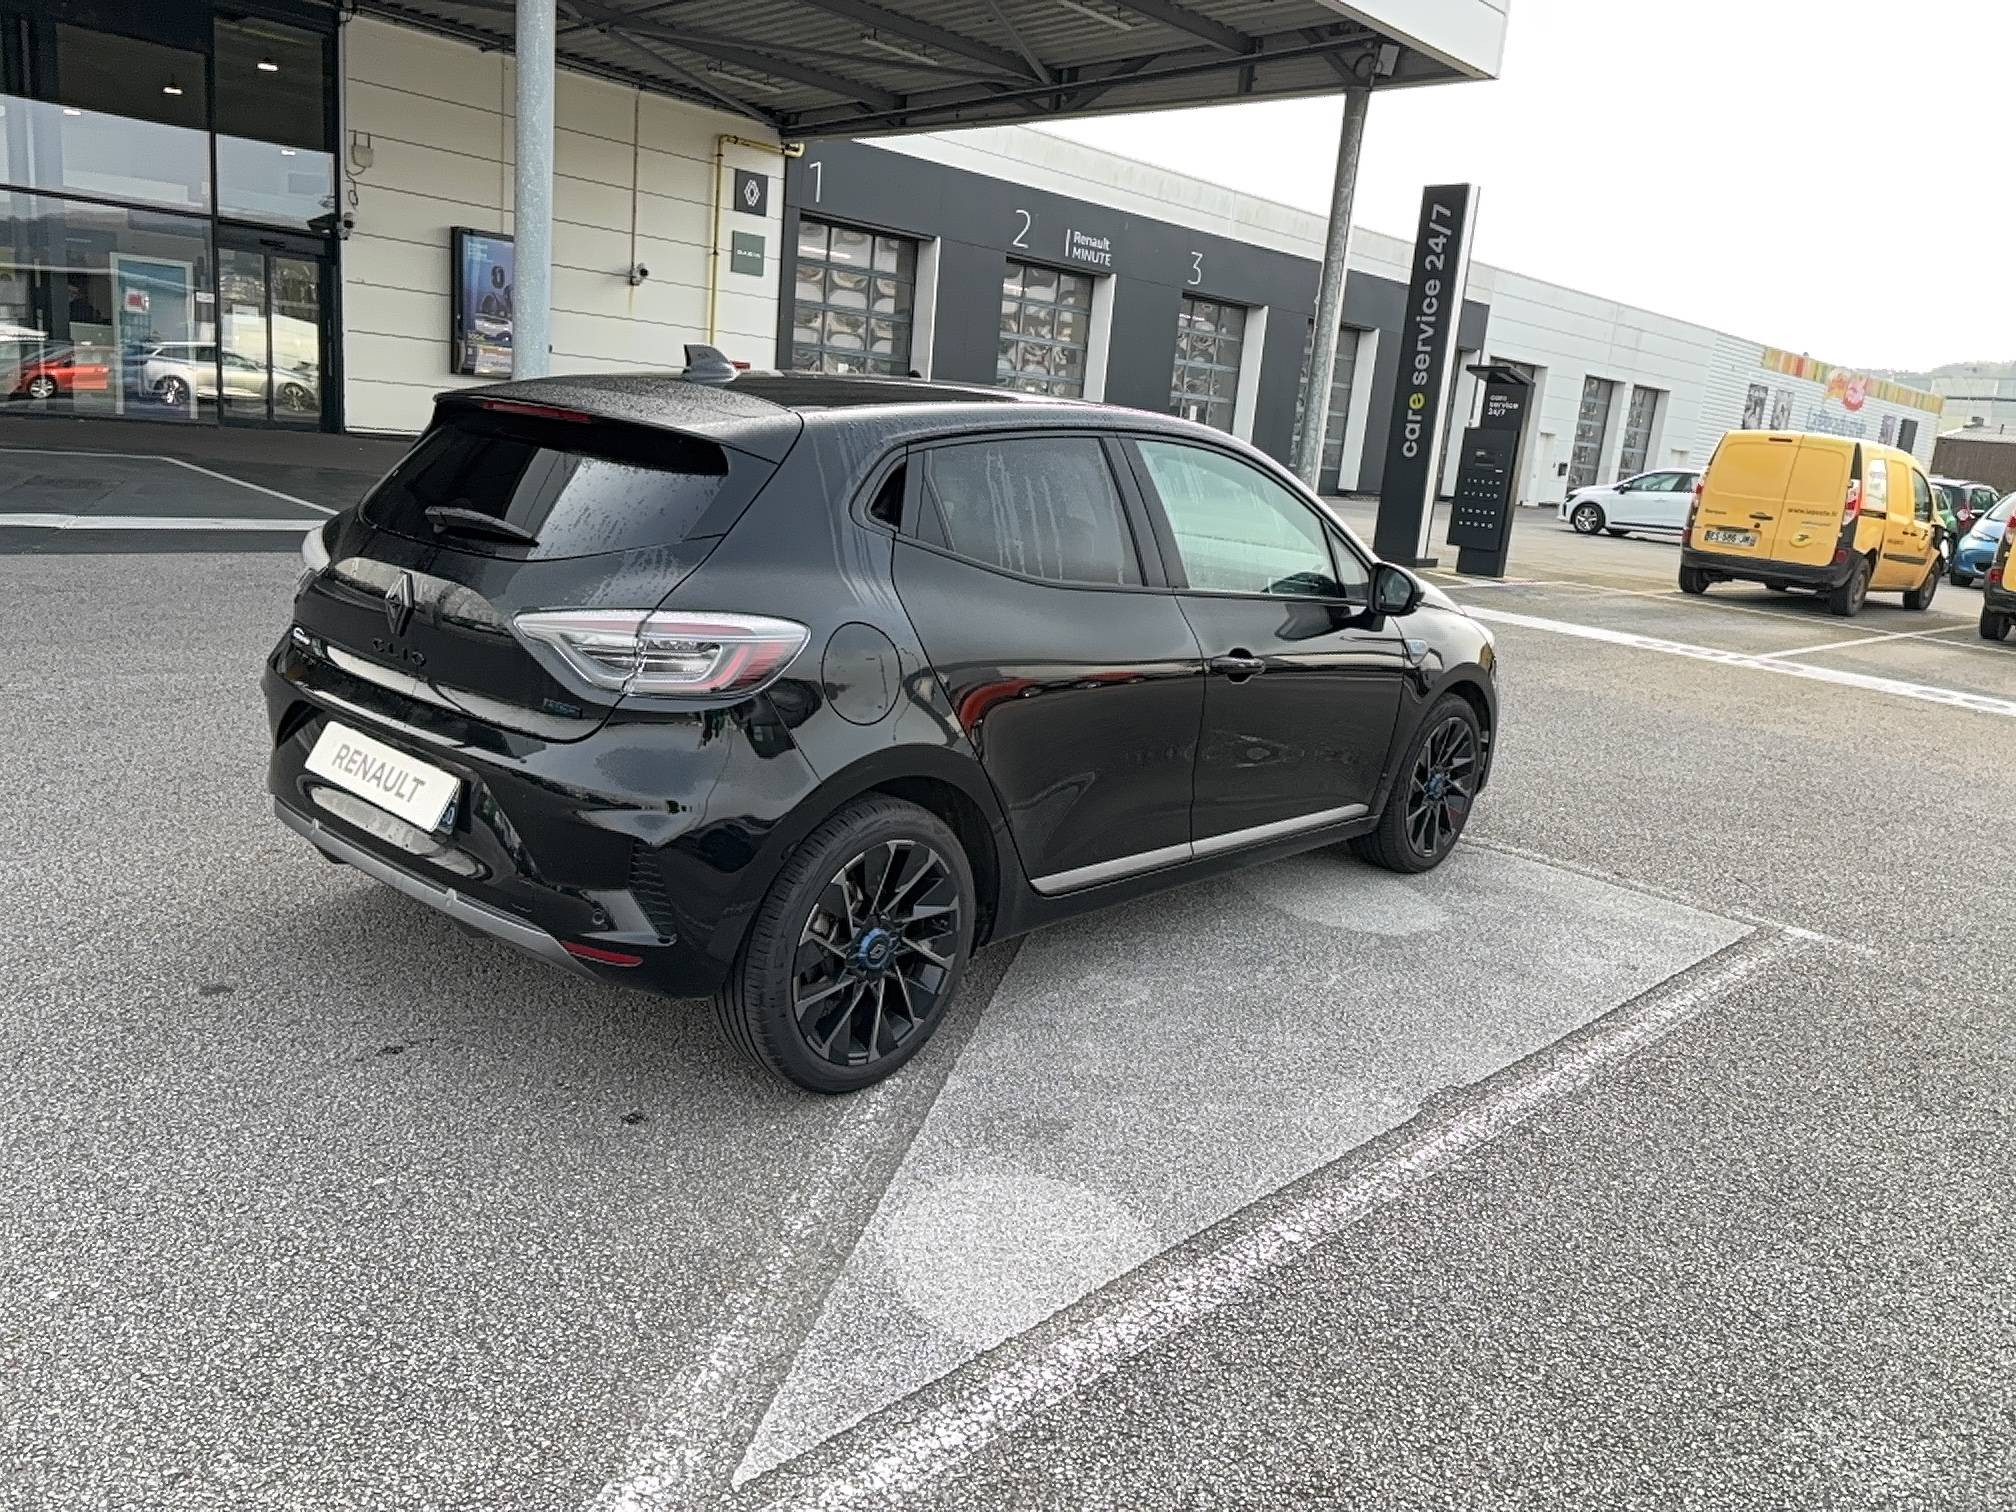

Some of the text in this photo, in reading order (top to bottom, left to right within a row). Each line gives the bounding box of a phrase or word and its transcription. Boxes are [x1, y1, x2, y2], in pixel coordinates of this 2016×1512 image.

[809, 161, 822, 203] 1
[1012, 209, 1031, 249] 2
[1073, 231, 1110, 251] Renault
[1072, 248, 1112, 267] MINUTE
[1187, 251, 1203, 285] 3
[1403, 204, 1452, 457] care service 24/7
[331, 743, 426, 803] RENAULT
